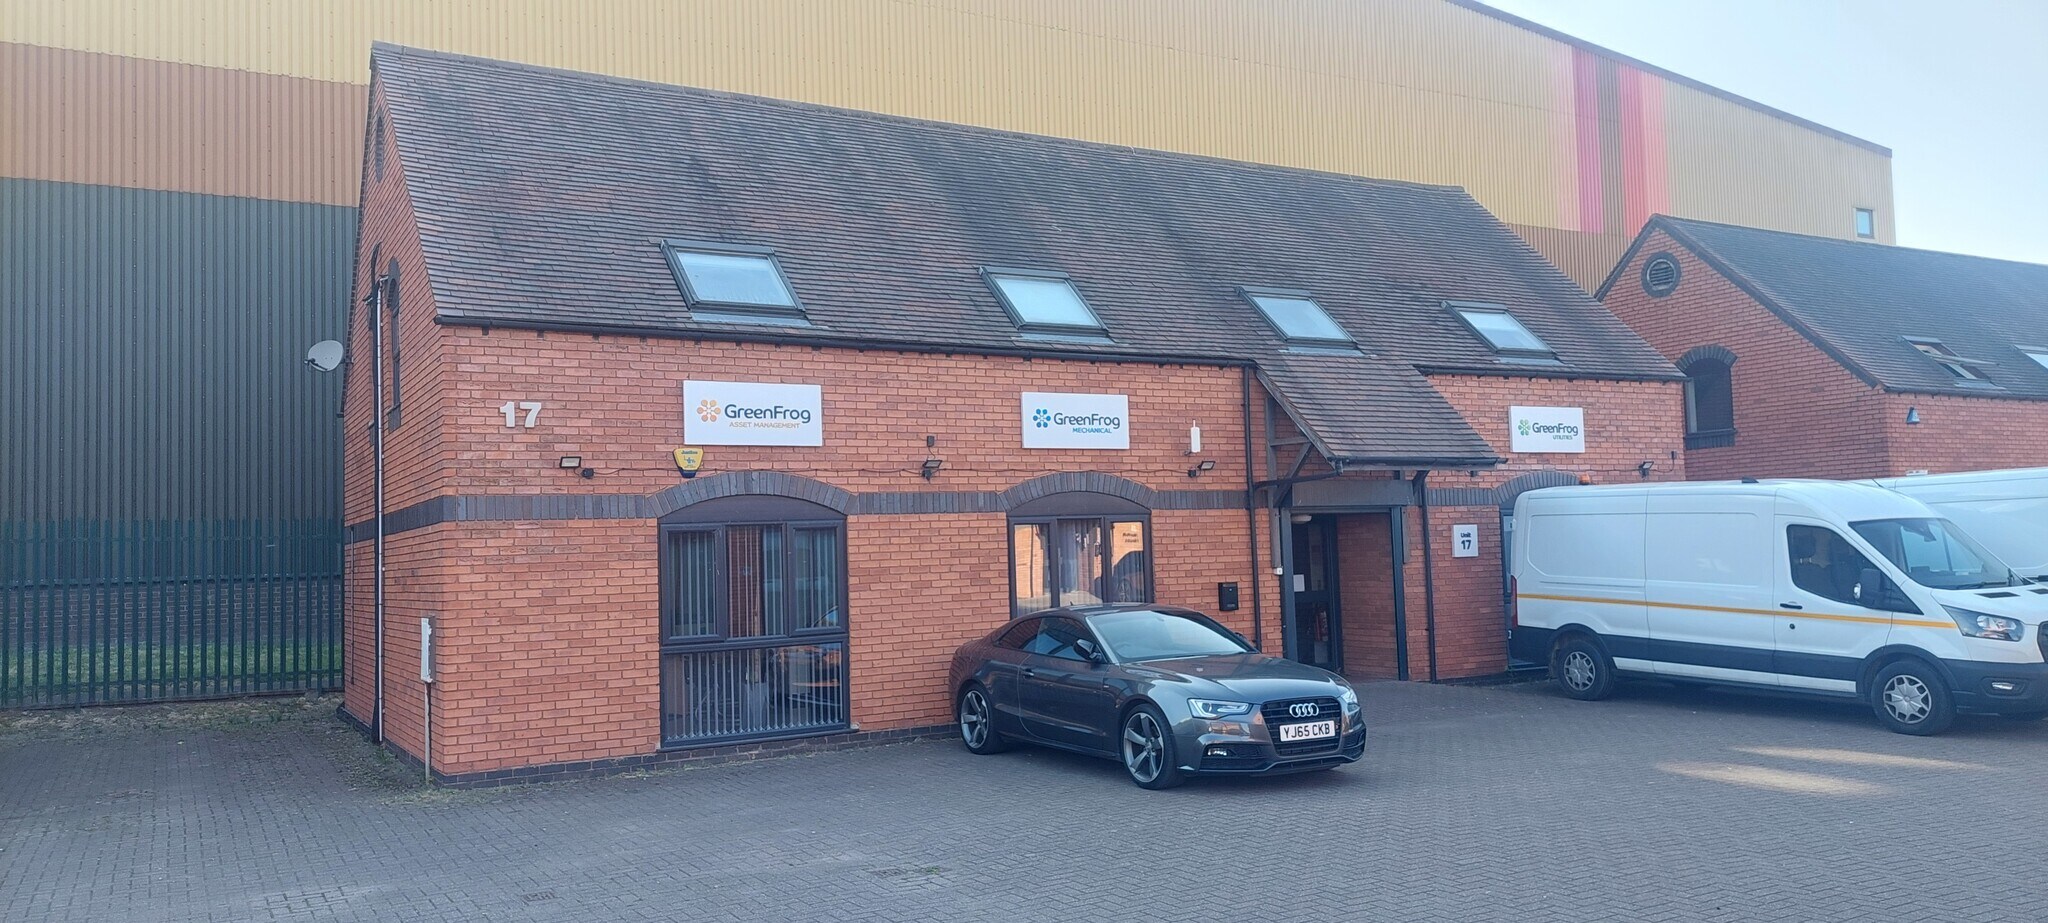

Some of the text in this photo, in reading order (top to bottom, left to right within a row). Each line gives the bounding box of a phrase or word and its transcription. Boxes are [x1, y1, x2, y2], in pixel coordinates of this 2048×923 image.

[500, 401, 542, 428] 17
[724, 404, 811, 424] GreenFrog
[1053, 412, 1120, 430] GreenFrog
[753, 421, 801, 429] MANAGEMENT
[1532, 422, 1579, 437] GreenFrog
[1461, 539, 1471, 550] 17
[1283, 723, 1331, 739] YJ65 CKB
